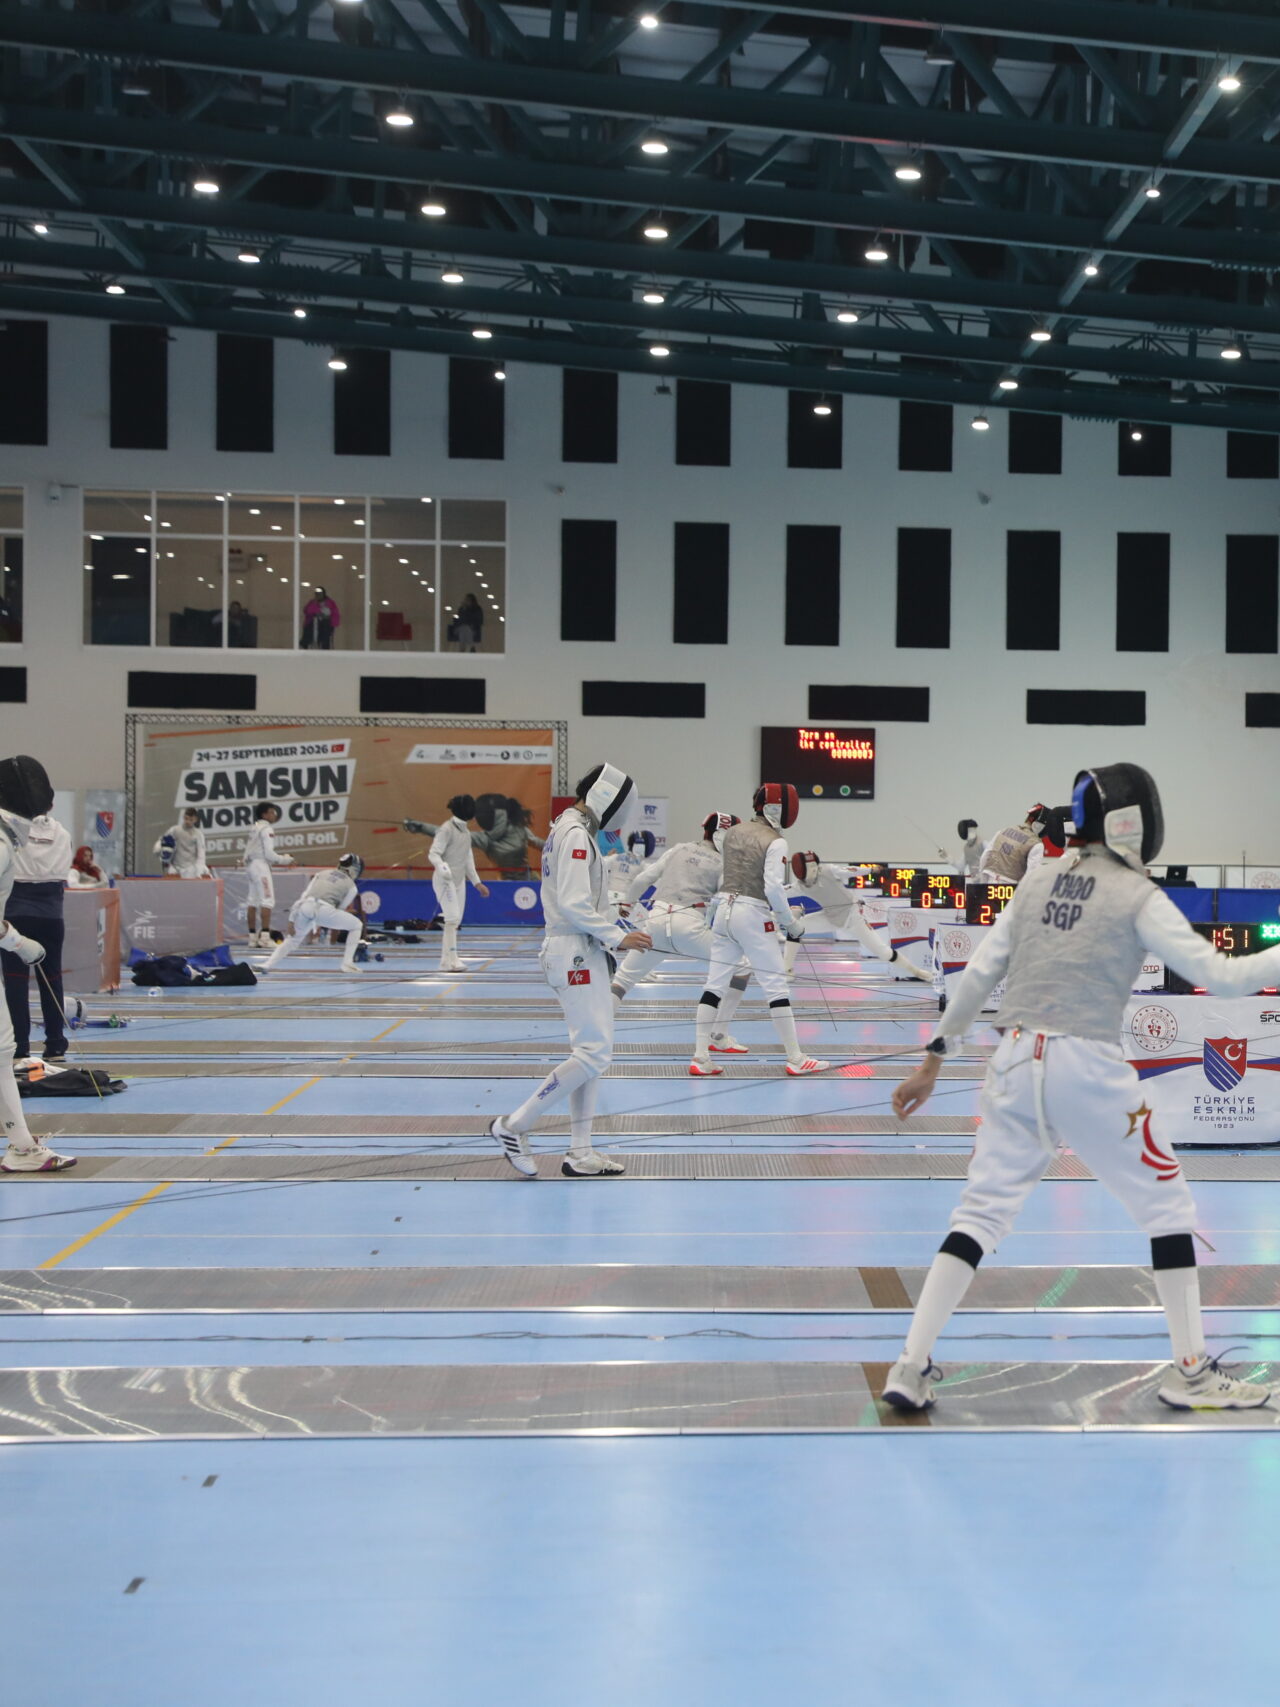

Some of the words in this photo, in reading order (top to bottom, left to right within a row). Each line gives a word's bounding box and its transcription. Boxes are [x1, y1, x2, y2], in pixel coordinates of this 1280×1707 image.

[232, 745, 298, 760] SEPTEMBER
[301, 742, 329, 755] 2026
[184, 765, 348, 802] SAMSUN
[289, 800, 340, 823] CUP
[307, 830, 339, 846] FOIL
[928, 876, 950, 888] 3:00
[922, 892, 931, 908] 0
[955, 892, 965, 908] 0
[987, 886, 1014, 900] 3:00
[980, 905, 991, 924] 2
[1042, 900, 1082, 931] SGP
[133, 926, 156, 939] FIE
[1194, 1095, 1255, 1105] TÜRKİYE
[1193, 1105, 1255, 1114] ESKRİM
